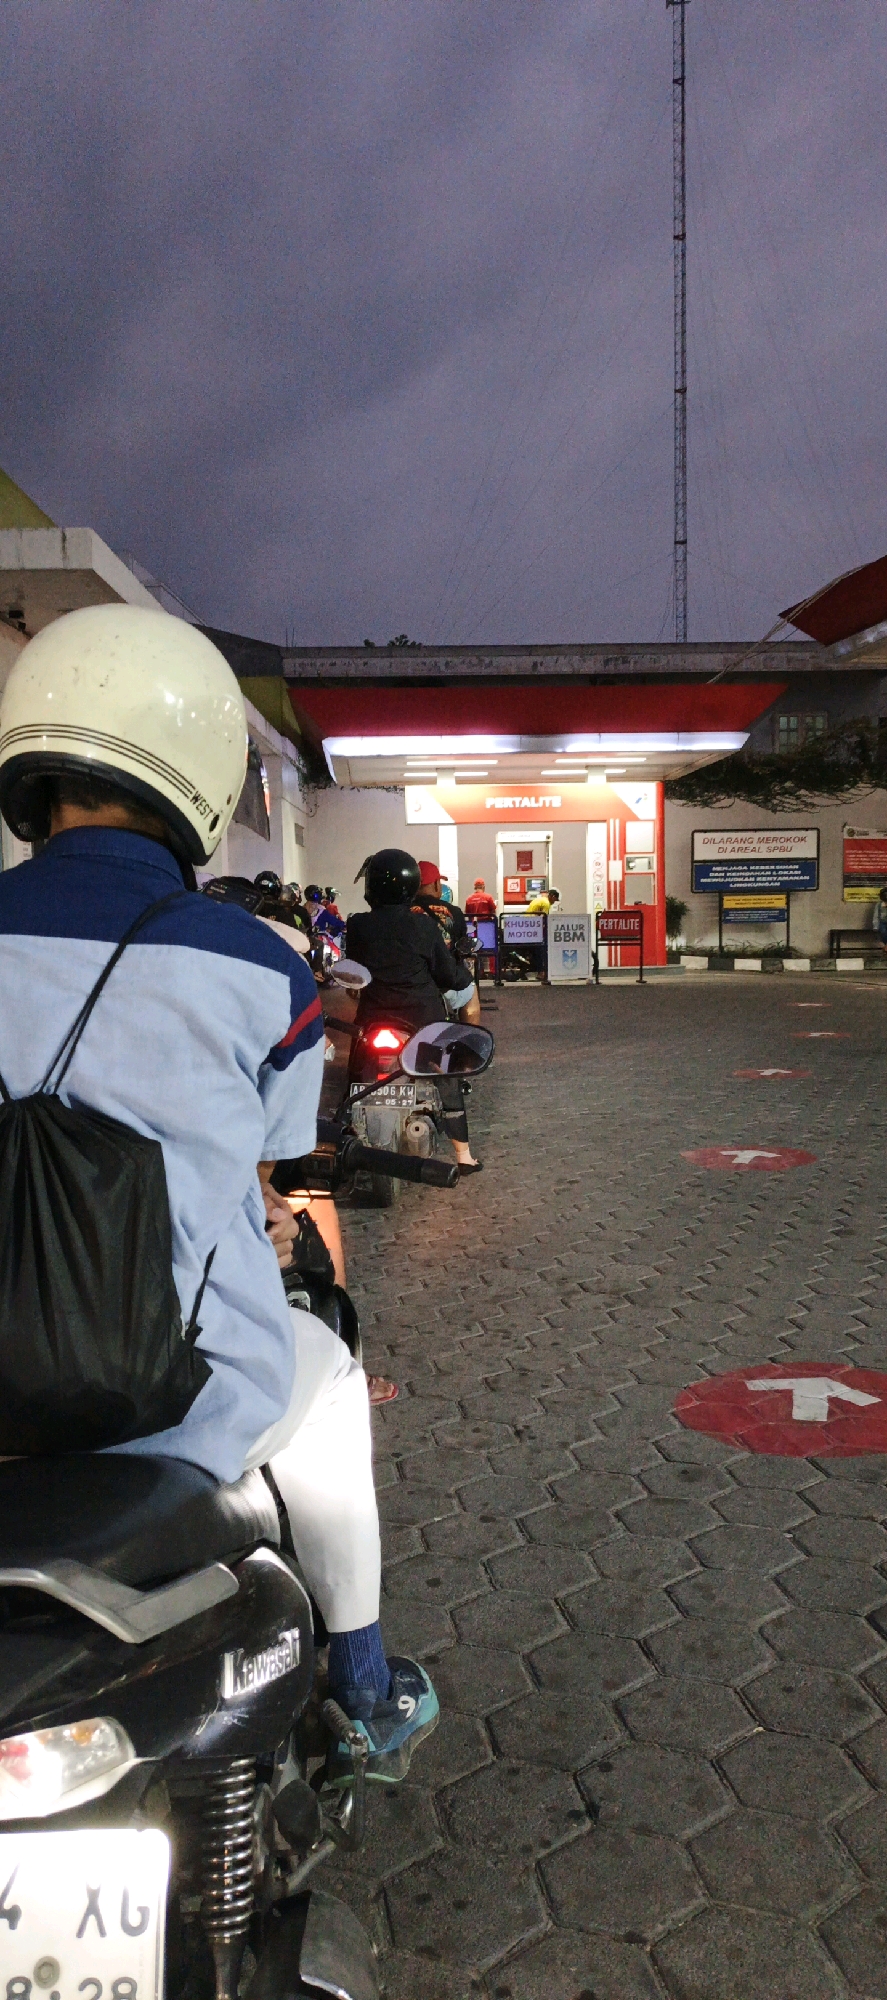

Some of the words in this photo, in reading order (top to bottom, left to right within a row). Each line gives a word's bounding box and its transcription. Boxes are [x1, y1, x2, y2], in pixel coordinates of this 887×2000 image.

[189, 790, 213, 820] WEST
[485, 796, 562, 809] PERTALITE
[702, 837, 754, 845] DILARANG
[756, 836, 808, 844] MEROKOK
[717, 846, 728, 854] DI
[729, 846, 763, 854] AREAL
[765, 845, 794, 853] SPBU
[504, 920, 541, 928] KHUSUS
[554, 923, 586, 932] JALUR
[598, 918, 640, 931] PERTALITE
[553, 932, 586, 943] BBM
[399, 1085, 414, 1096] KW
